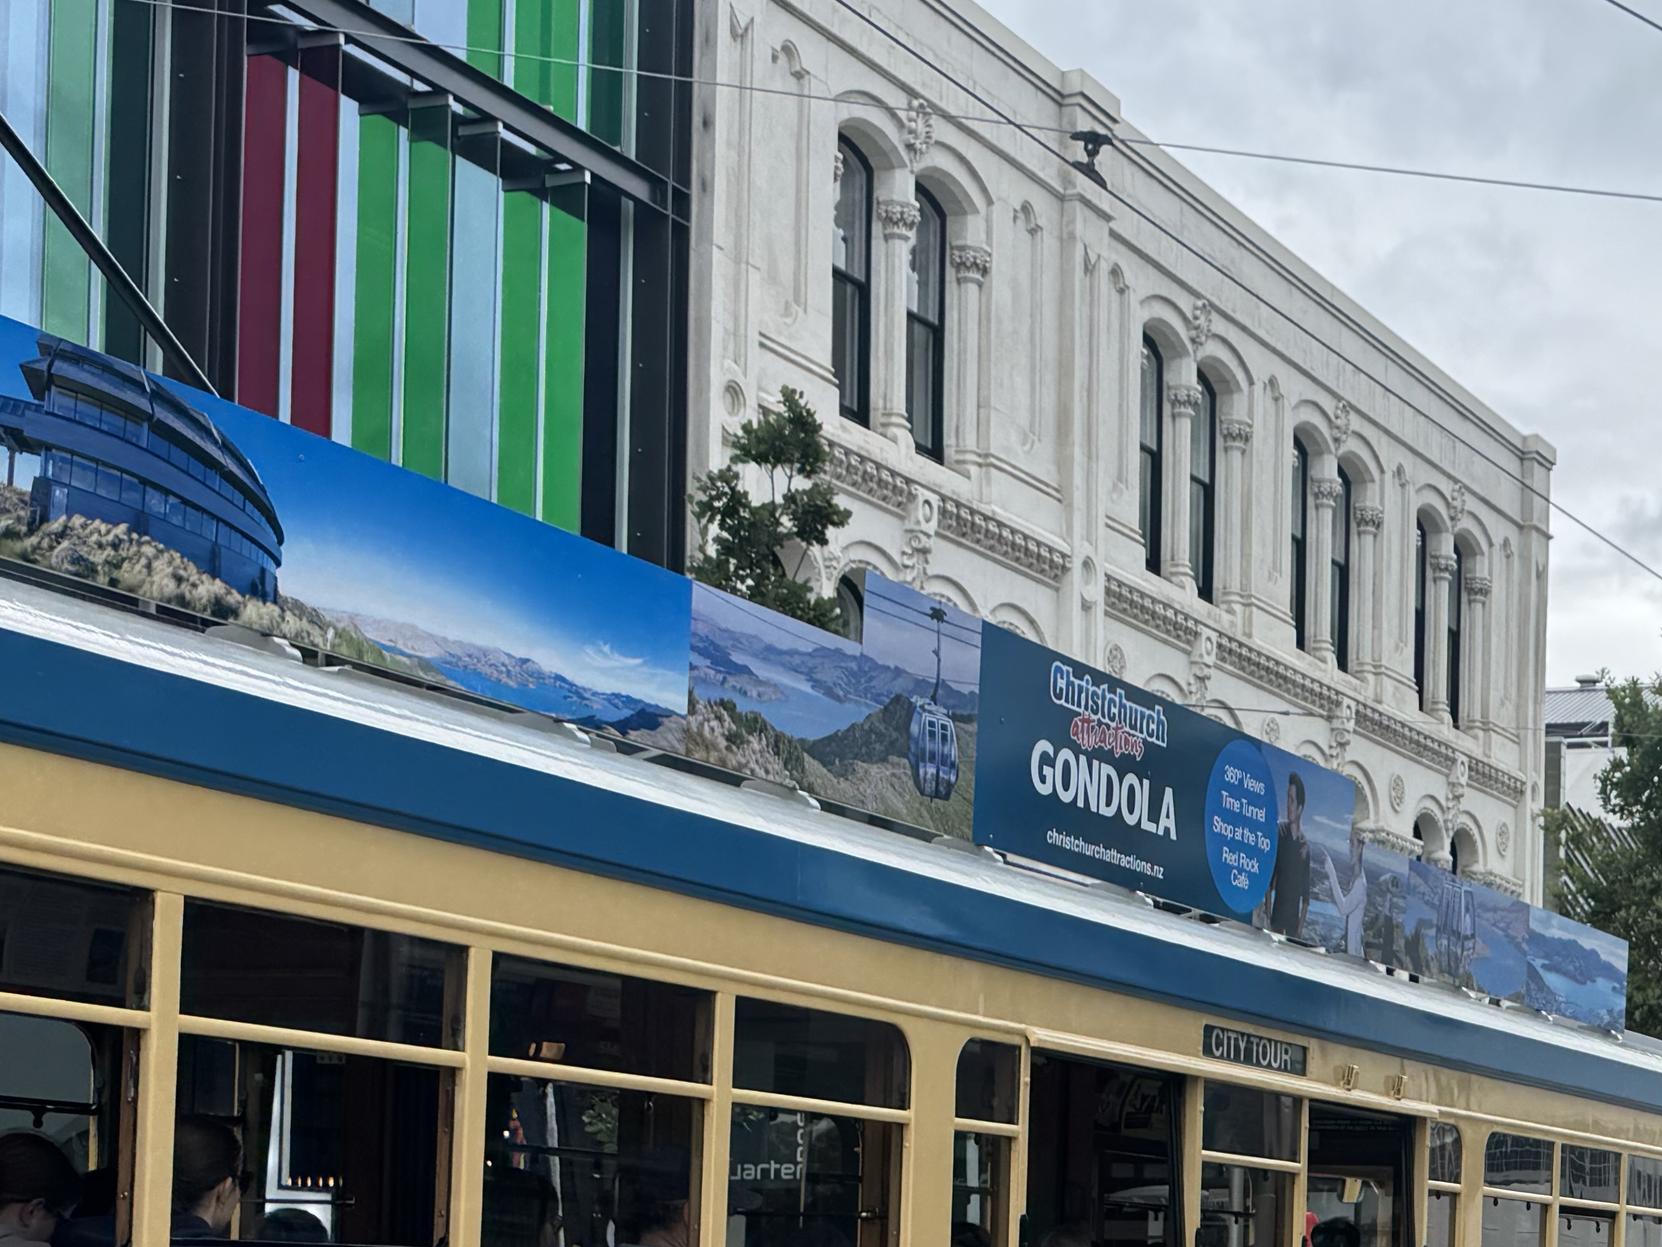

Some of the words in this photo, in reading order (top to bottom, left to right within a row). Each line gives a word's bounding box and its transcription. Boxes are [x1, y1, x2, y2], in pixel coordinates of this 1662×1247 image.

[1051, 661, 1167, 747] Christchurch
[1071, 712, 1144, 760] attractions
[1031, 739, 1177, 840] GONDOLA
[1243, 771, 1265, 795] Views
[1221, 790, 1240, 812] Time
[1241, 798, 1265, 822] Tunnel
[1046, 829, 1164, 879] christchurchattractions.nz
[1213, 815, 1233, 840] Shop
[1234, 826, 1243, 841] at
[1244, 829, 1256, 846] the
[1256, 831, 1270, 853] Top
[1222, 847, 1239, 866] Red
[1239, 852, 1259, 874] Rock
[1230, 869, 1249, 890] Café
[1211, 1028, 1248, 1062] CITY
[1249, 1038, 1292, 1071] TOUR
